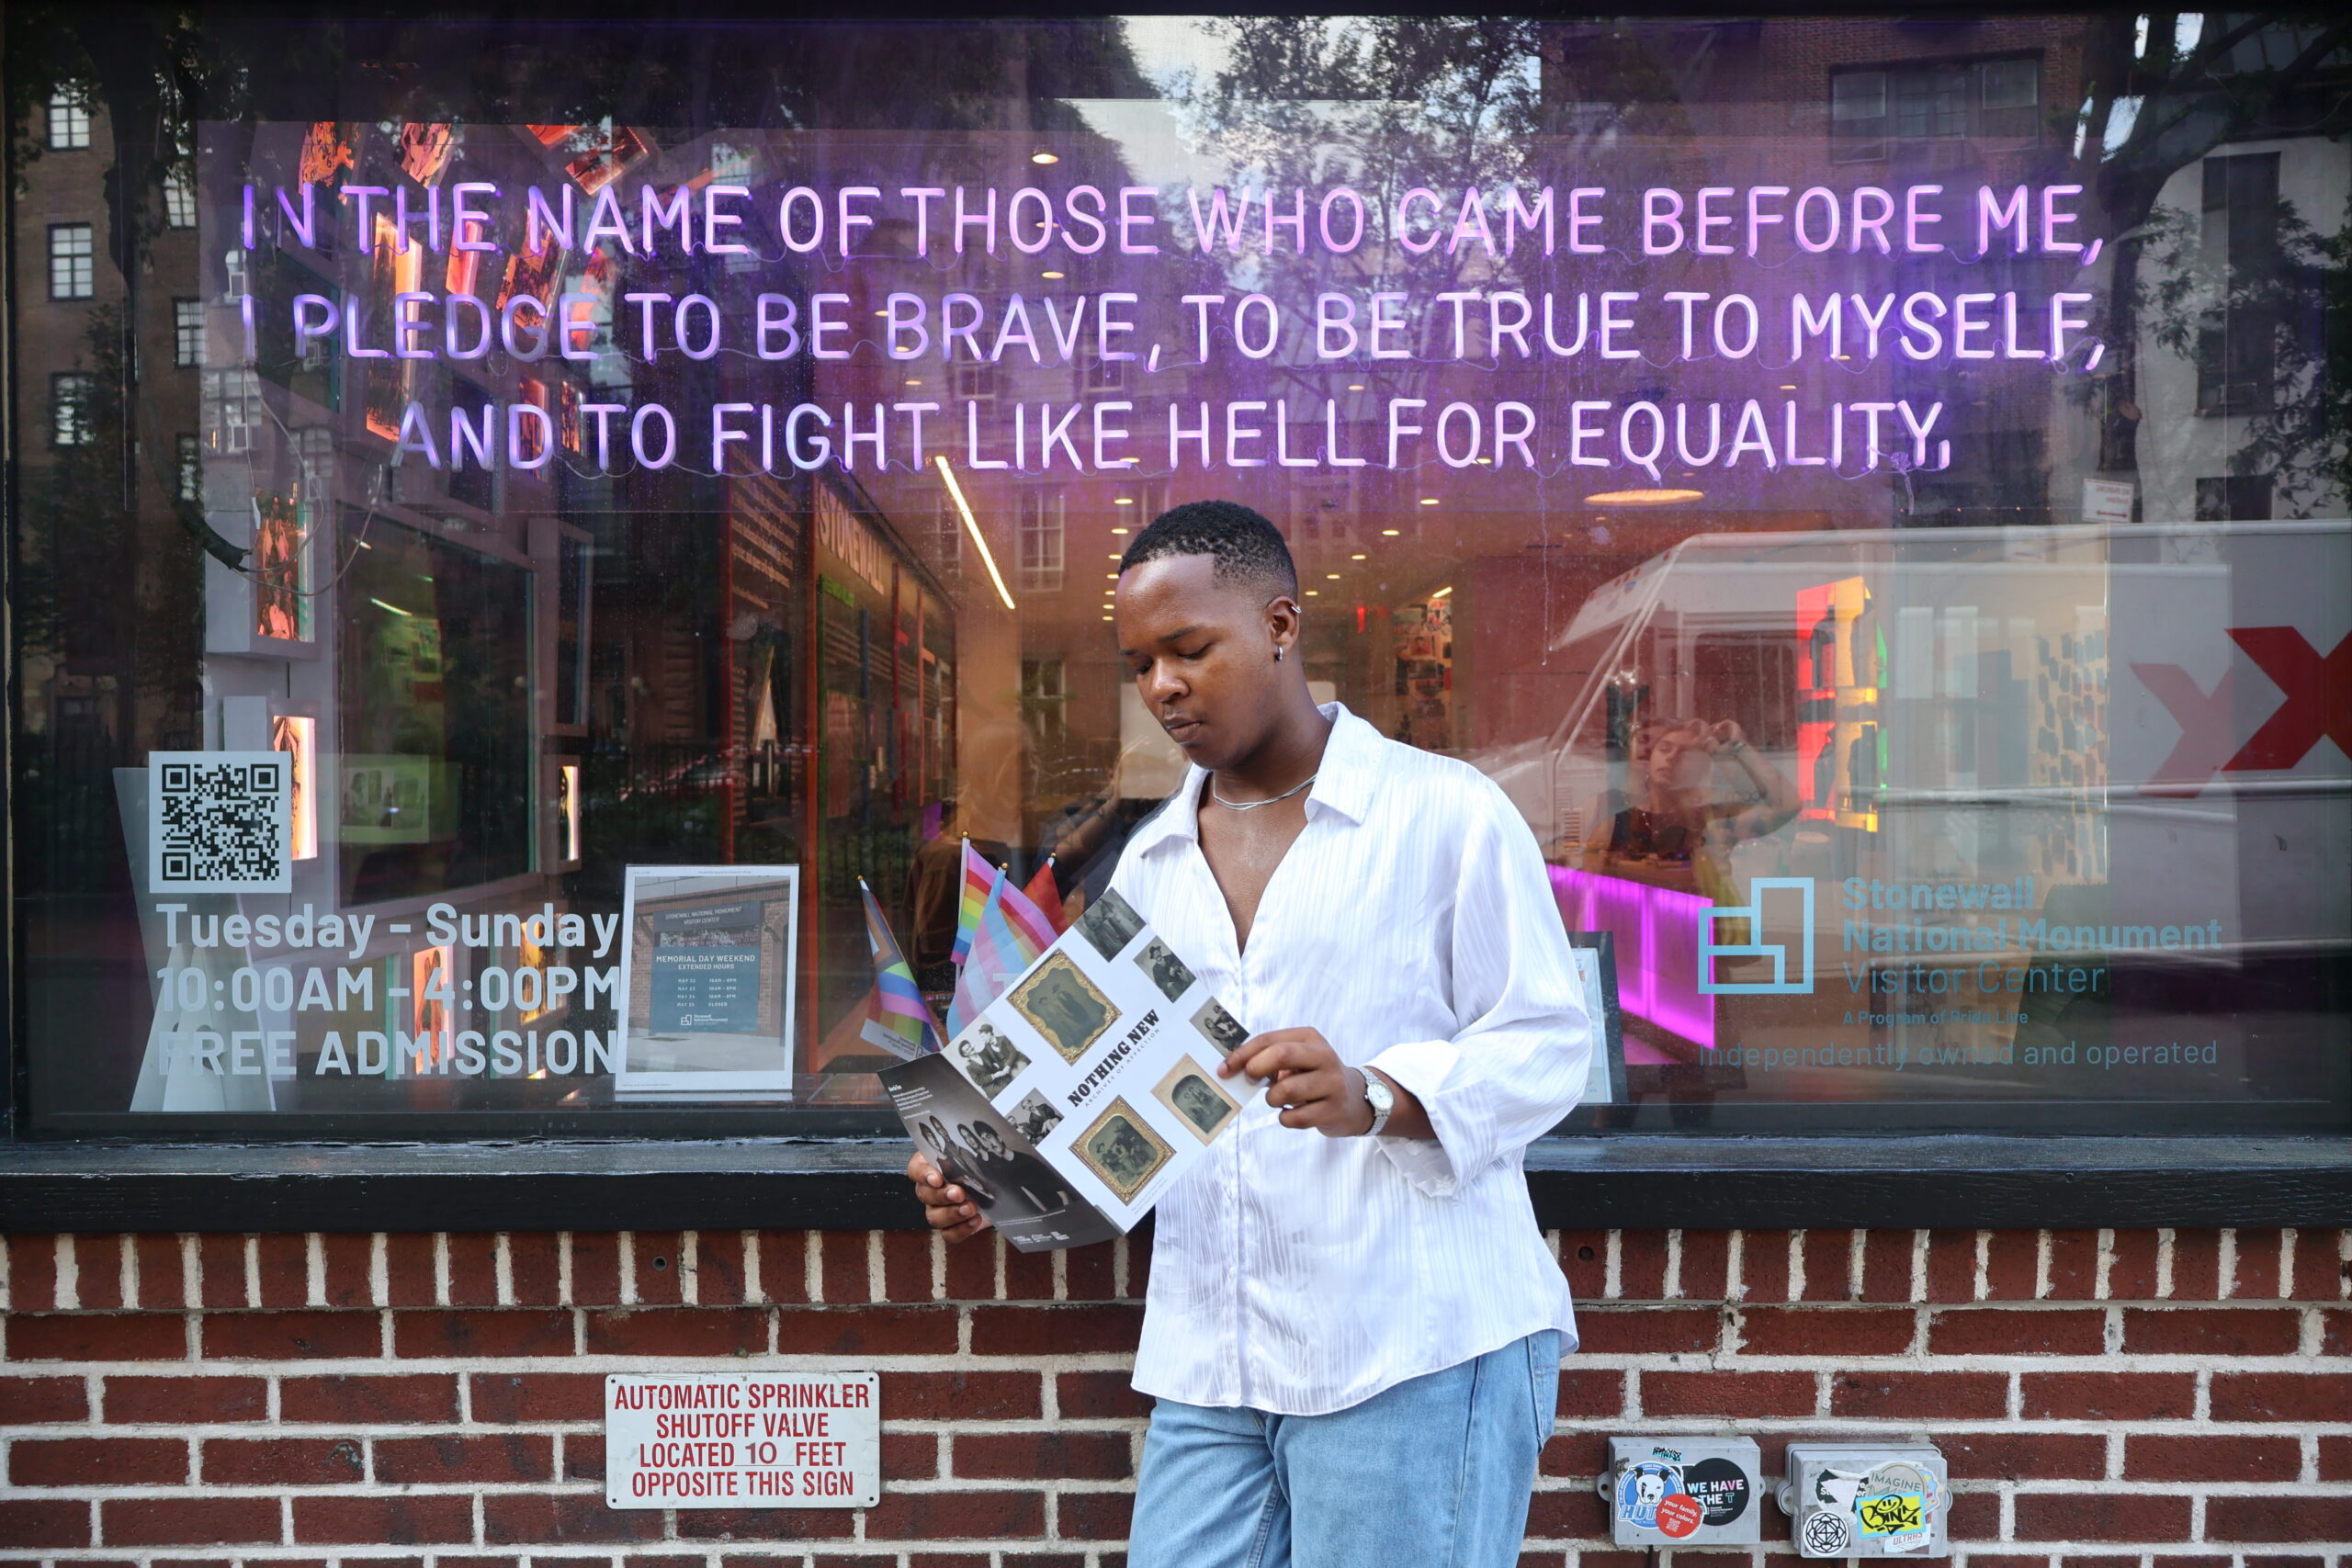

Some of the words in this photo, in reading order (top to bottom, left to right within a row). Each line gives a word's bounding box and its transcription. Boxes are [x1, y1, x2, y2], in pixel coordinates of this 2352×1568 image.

[243, 183, 316, 250] IN
[341, 183, 502, 254] THE
[527, 183, 753, 255] NAME
[780, 186, 880, 256] OF
[900, 186, 1159, 257] THOSE
[1187, 186, 1365, 255] WHO
[1396, 186, 1606, 255] CAME
[1642, 185, 1945, 256] BEFORE
[1977, 185, 2103, 265] ME,
[242, 293, 256, 359] I
[292, 291, 600, 362] PLEDGE
[625, 292, 721, 364] TO
[756, 292, 851, 360] BE
[887, 292, 1161, 372] BRAVE,
[1181, 292, 1280, 363] TO
[1316, 291, 1411, 360] BE
[1435, 291, 1640, 360] TRUE
[1663, 291, 1759, 361] TO
[1790, 290, 2106, 371] MYSELF,
[390, 400, 554, 471] AND
[579, 402, 678, 472] TO
[712, 401, 940, 473] FIGHT
[967, 400, 1134, 471] LIKE
[1170, 399, 1367, 469] HELL
[1387, 399, 1536, 469] FOR
[1843, 876, 2035, 910] Stonewall
[155, 902, 376, 959] Tuesday
[425, 902, 619, 959] Sunday
[1843, 918, 2007, 952] National
[2018, 917, 2223, 951] Monument
[155, 965, 374, 1011] 10:00AM
[424, 965, 620, 1011] 4:00PM
[1843, 960, 1968, 995] Visitor
[1977, 960, 2106, 993] Center
[1843, 1011, 1854, 1025] A
[1858, 1010, 1927, 1028] Program
[1930, 1010, 1947, 1025] of
[1950, 1010, 1992, 1025] Pride
[1996, 1010, 2030, 1025] Live
[158, 1030, 297, 1076] FREE
[314, 1029, 617, 1076] ADMISSION
[1067, 1040, 1132, 1108] NOTHING
[1126, 1009, 1159, 1045] NEW
[1084, 1076, 1115, 1108] ARCHIVES
[1126, 1028, 1160, 1064] AFFECTION
[1700, 1041, 1909, 1072] Independently
[1918, 1041, 2015, 1065] owned
[2024, 1040, 2075, 1066] and
[2086, 1039, 2217, 1070] operated
[614, 1384, 740, 1410] AUTOMATIC
[748, 1383, 869, 1408] SPRINKLER
[656, 1413, 755, 1438] SHUTOFF
[763, 1413, 830, 1438] VALVE
[639, 1442, 735, 1468] LOCATED
[745, 1441, 777, 1465] 10
[796, 1441, 846, 1467] FEET
[632, 1472, 738, 1497] OPPOSITE
[745, 1471, 795, 1496] THIS
[802, 1471, 854, 1496] SIGN
[1687, 1482, 1708, 1495] WE
[1710, 1479, 1745, 1493] HAVE
[1698, 1494, 1724, 1506] THE
[1724, 1492, 1736, 1504] T
[1871, 1472, 1922, 1493] IMAGINE
[1660, 1507, 1676, 1517] your
[1664, 1499, 1679, 1508] your
